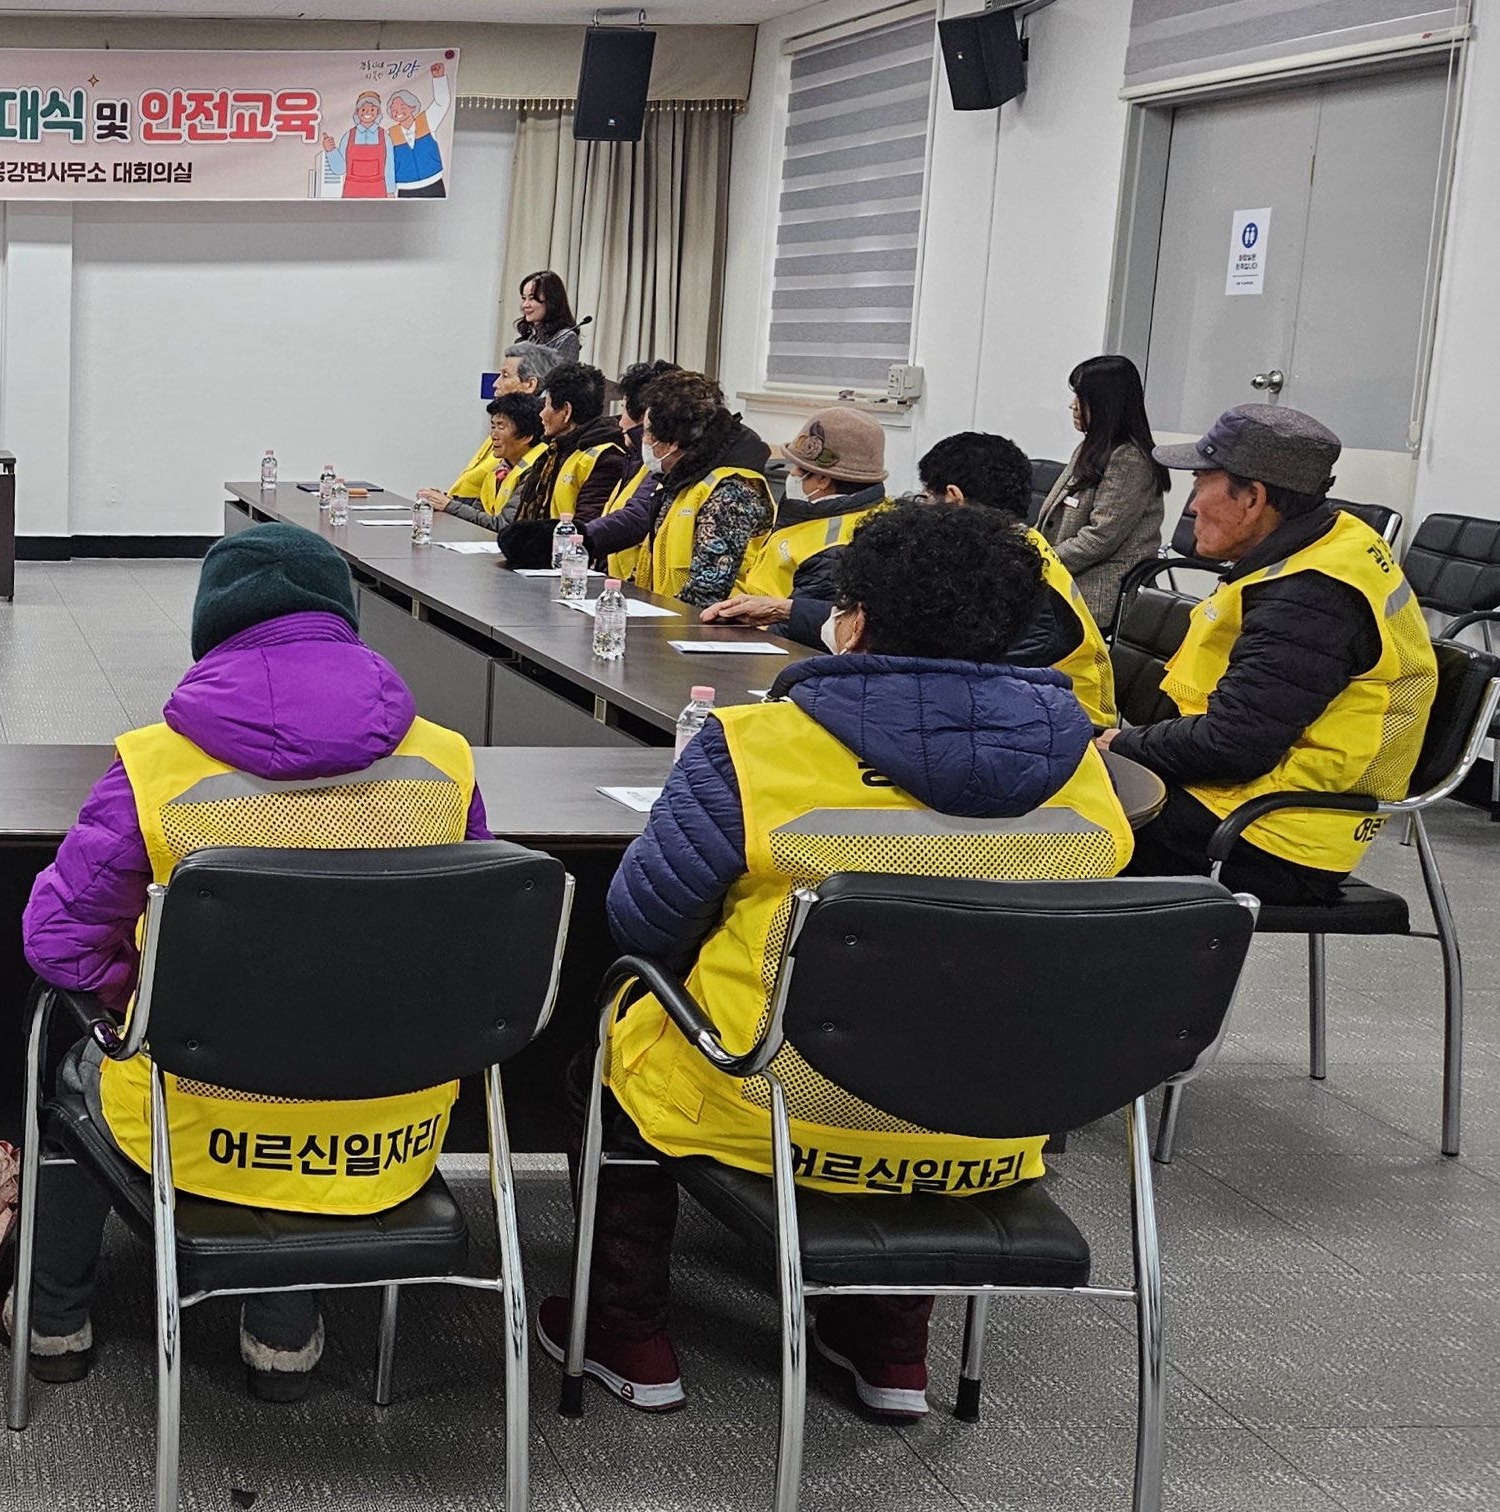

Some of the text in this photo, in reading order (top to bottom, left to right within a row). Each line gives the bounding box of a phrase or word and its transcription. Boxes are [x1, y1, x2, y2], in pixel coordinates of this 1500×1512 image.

[386, 59, 421, 80] 광양
[95, 102, 130, 141] 및
[139, 91, 321, 142] 안전교육
[113, 161, 193, 184] 대회의실
[208, 1112, 443, 1177] 어르신일자리
